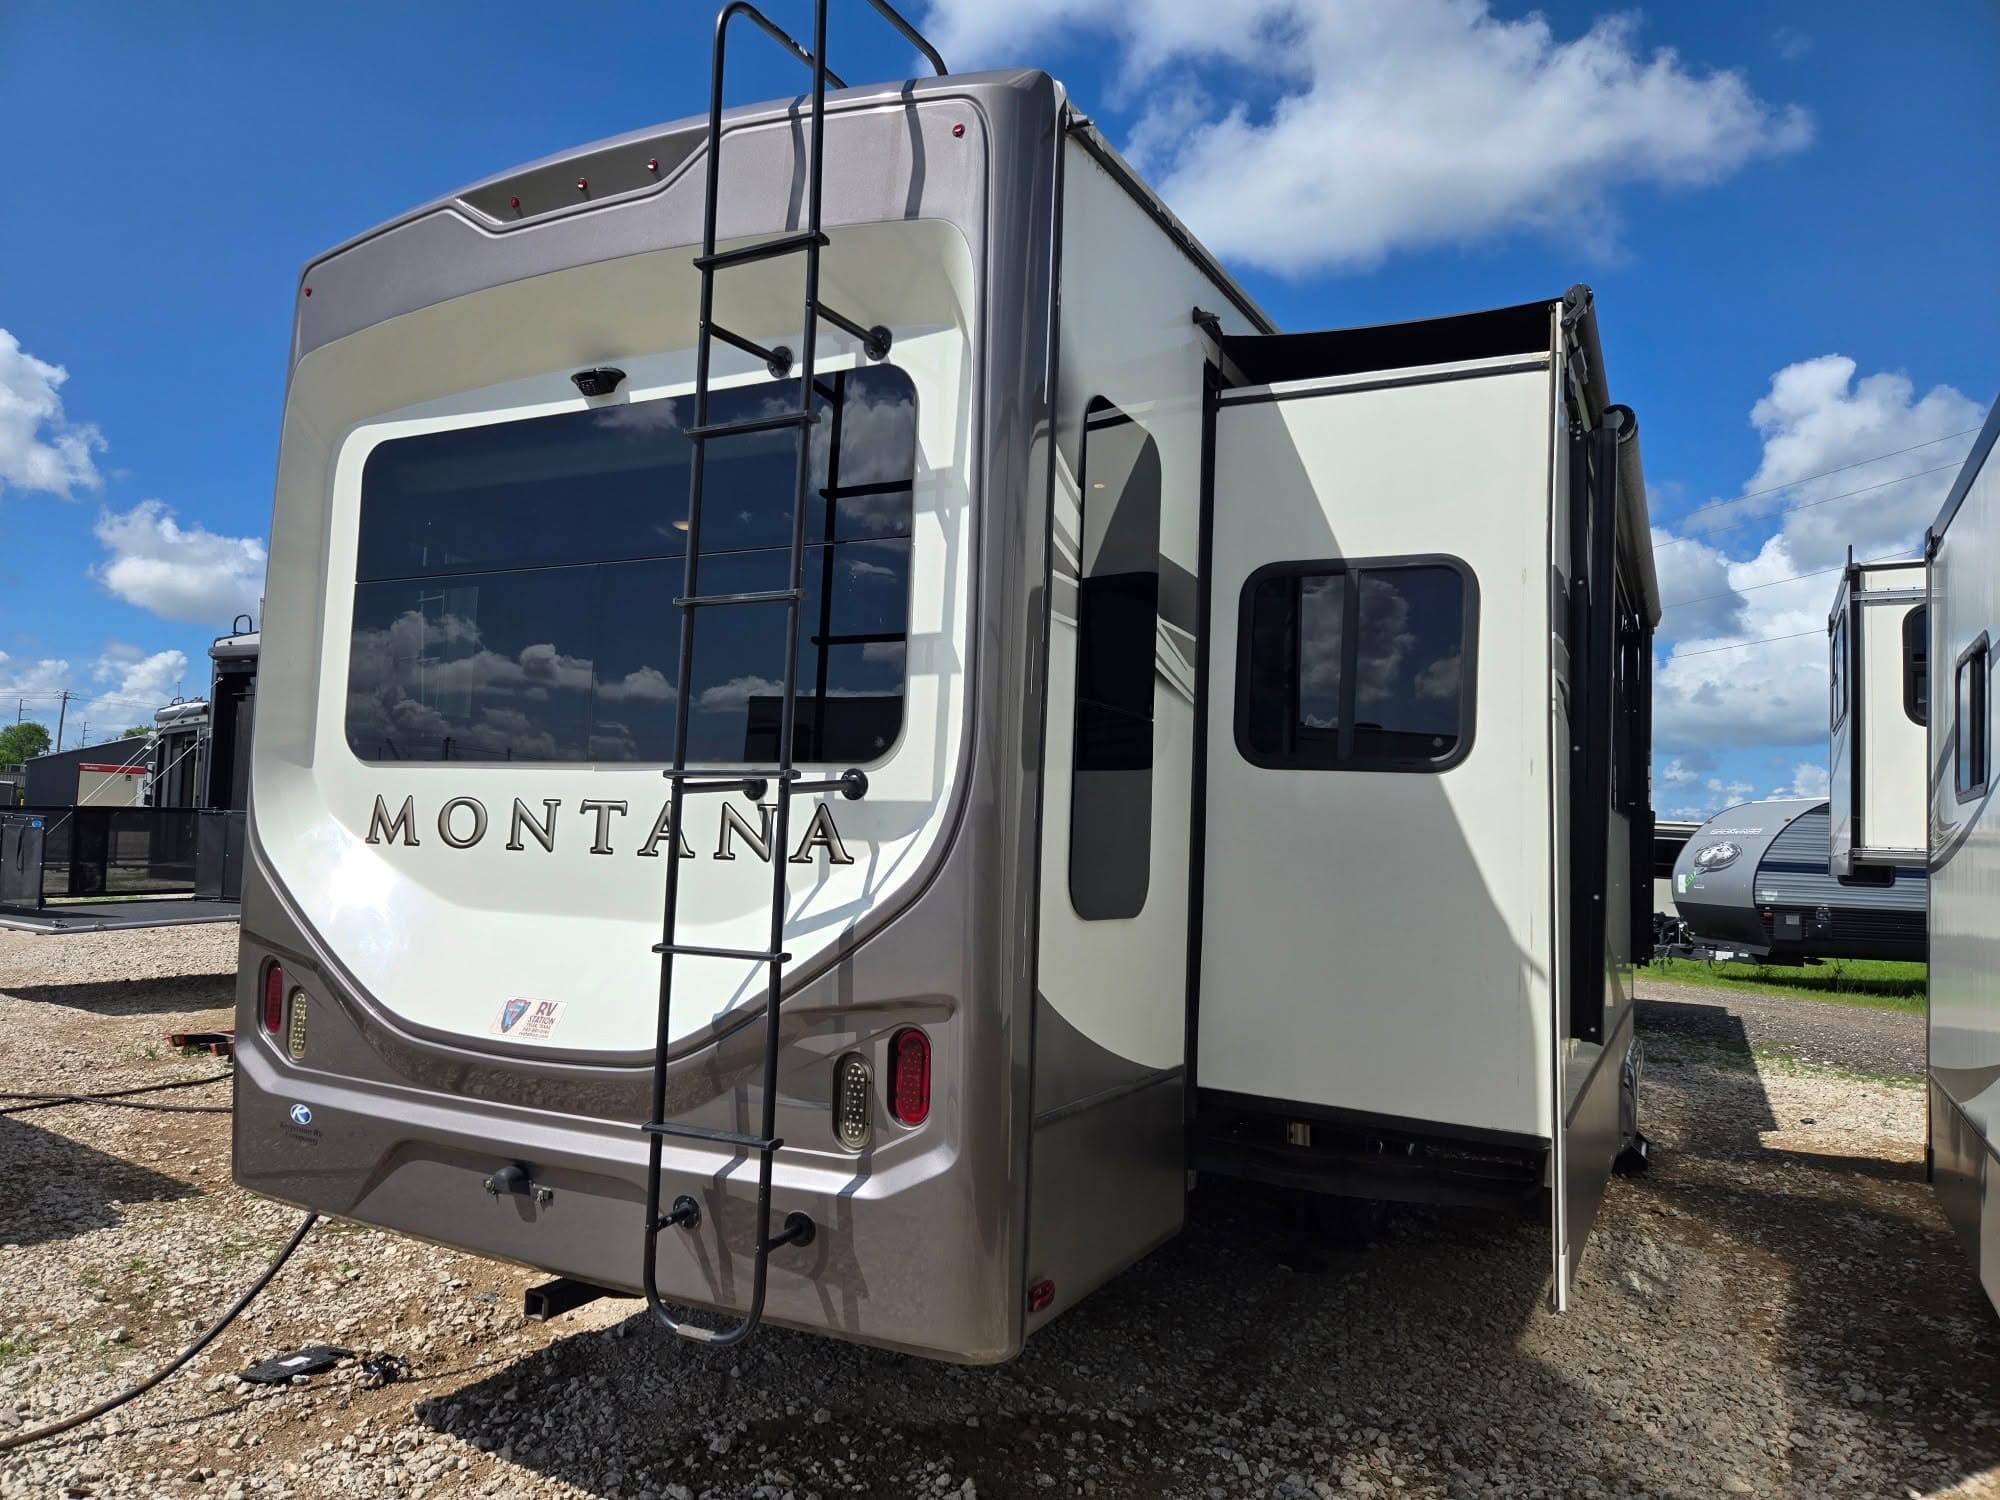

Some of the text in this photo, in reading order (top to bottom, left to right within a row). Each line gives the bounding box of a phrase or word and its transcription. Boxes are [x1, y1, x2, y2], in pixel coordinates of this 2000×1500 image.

[364, 794, 856, 865] MONTANA
[535, 1002, 558, 1016] RV
[527, 1015, 555, 1025] STATION
